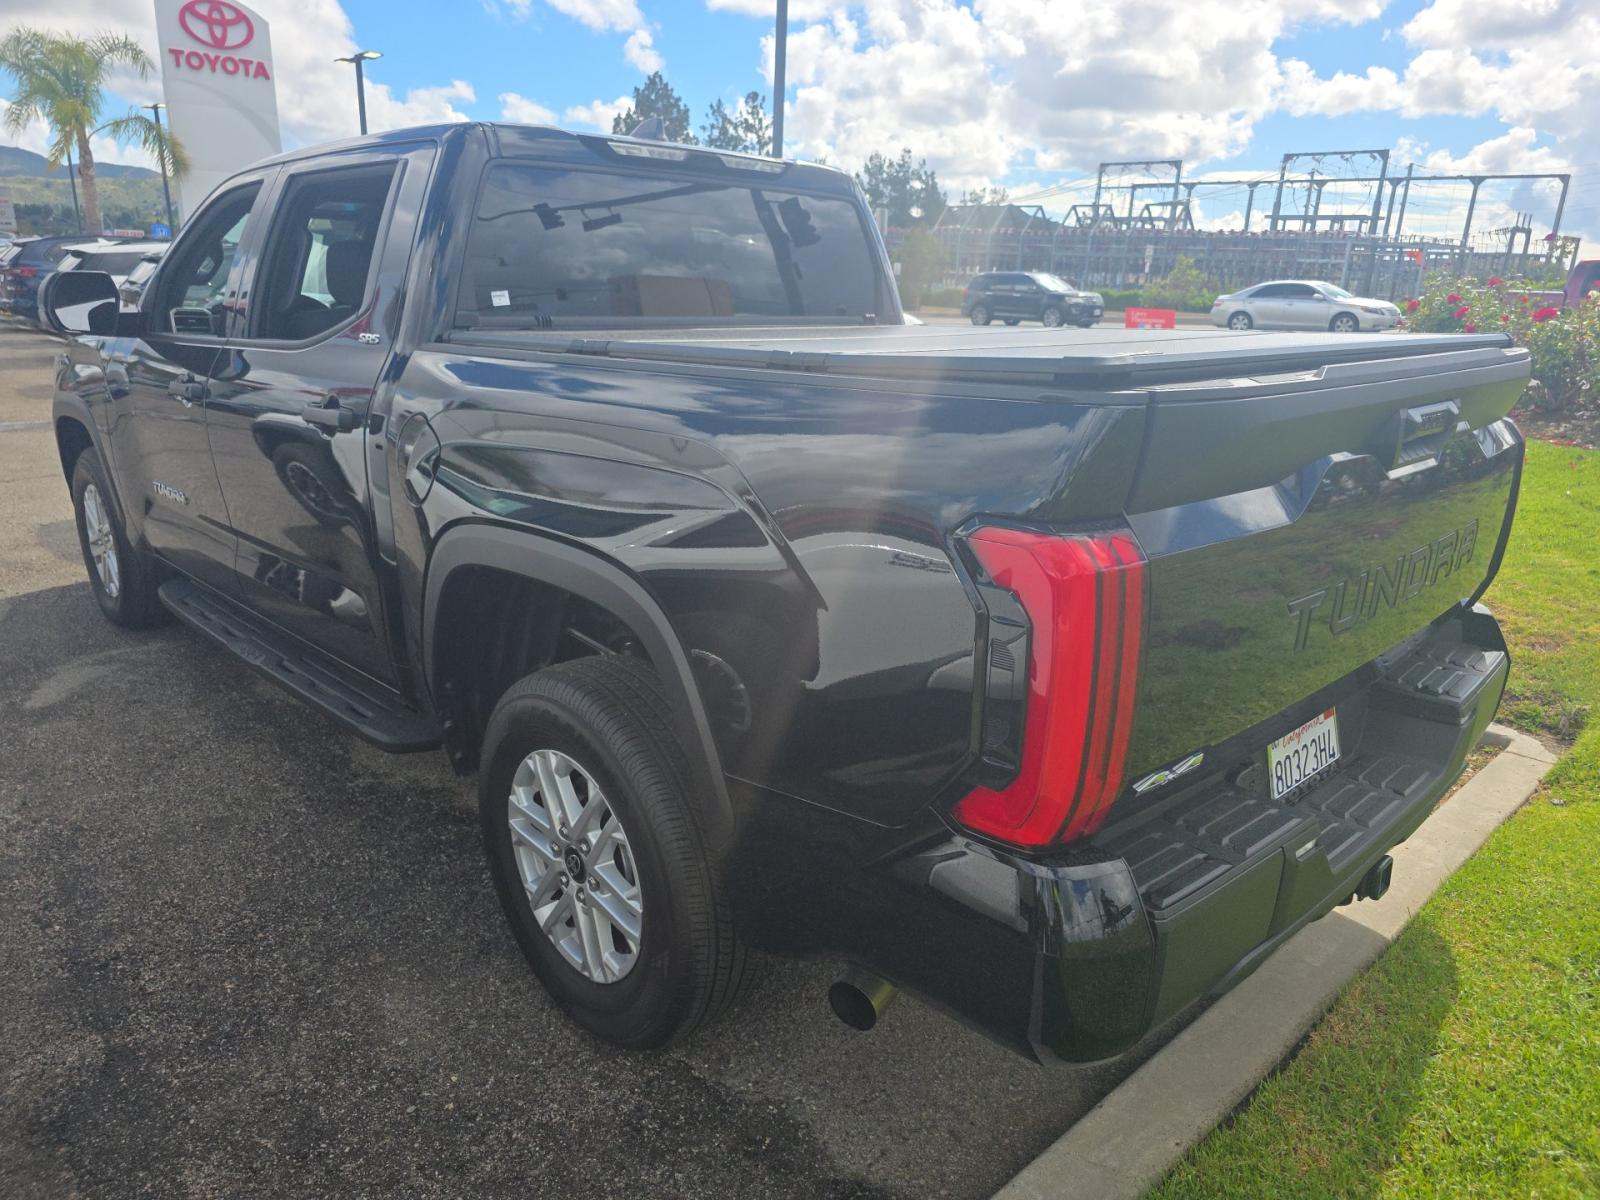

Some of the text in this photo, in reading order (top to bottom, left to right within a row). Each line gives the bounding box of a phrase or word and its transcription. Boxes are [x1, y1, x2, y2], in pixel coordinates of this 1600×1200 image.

[168, 47, 270, 80] TOYOTA
[1287, 518, 1480, 655] TUNDRA
[1275, 729, 1336, 795] 80323H4
